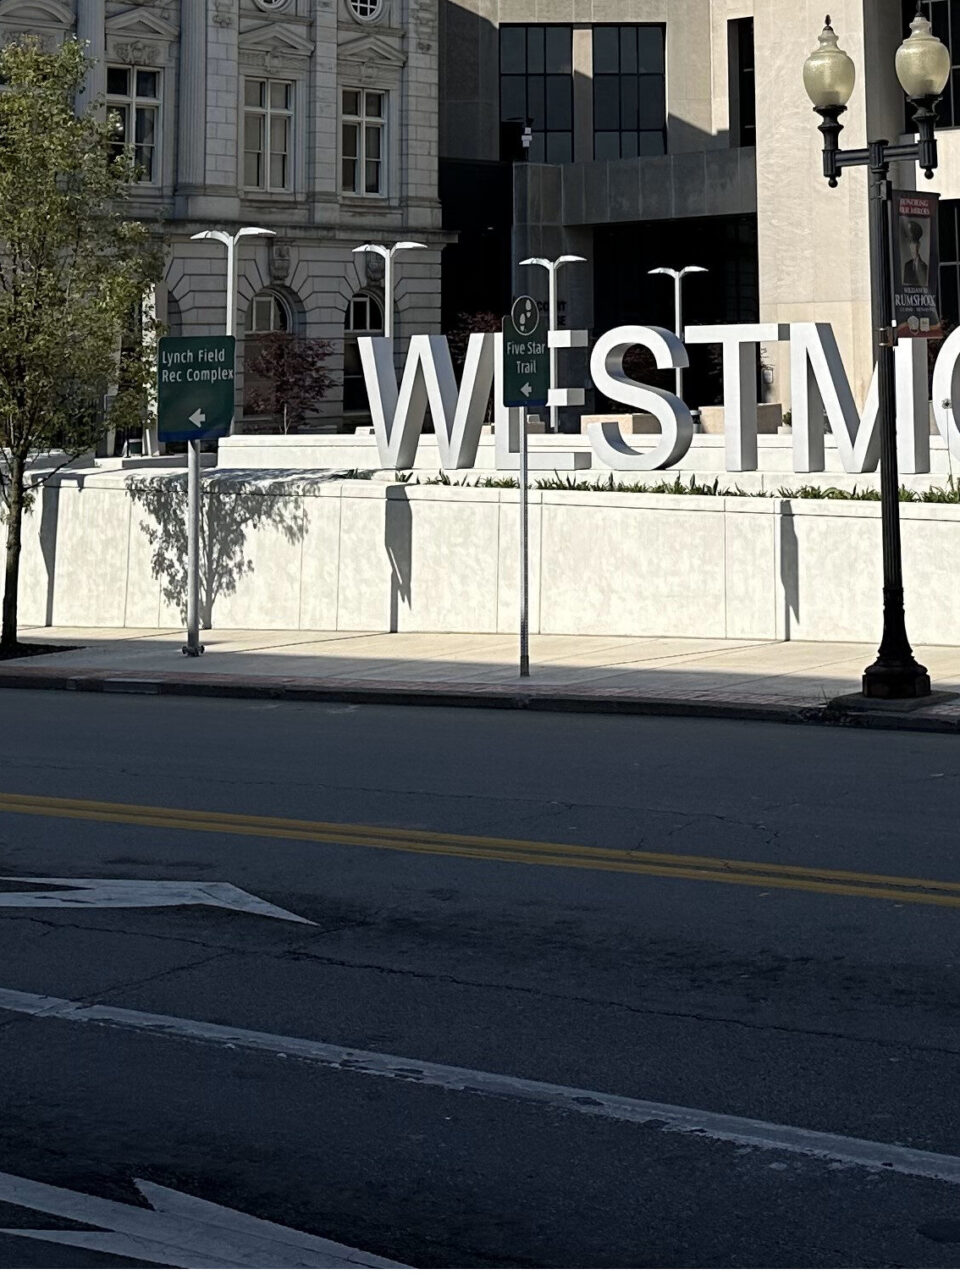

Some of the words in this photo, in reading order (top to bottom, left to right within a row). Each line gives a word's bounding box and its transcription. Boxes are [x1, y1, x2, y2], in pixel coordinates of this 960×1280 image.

[506, 341, 526, 355] Five
[527, 341, 546, 355] Star
[162, 349, 194, 367] Lynch
[198, 348, 225, 363] Field
[162, 369, 183, 383] Rec
[186, 366, 234, 384] Complex
[516, 360, 537, 374] Trail
